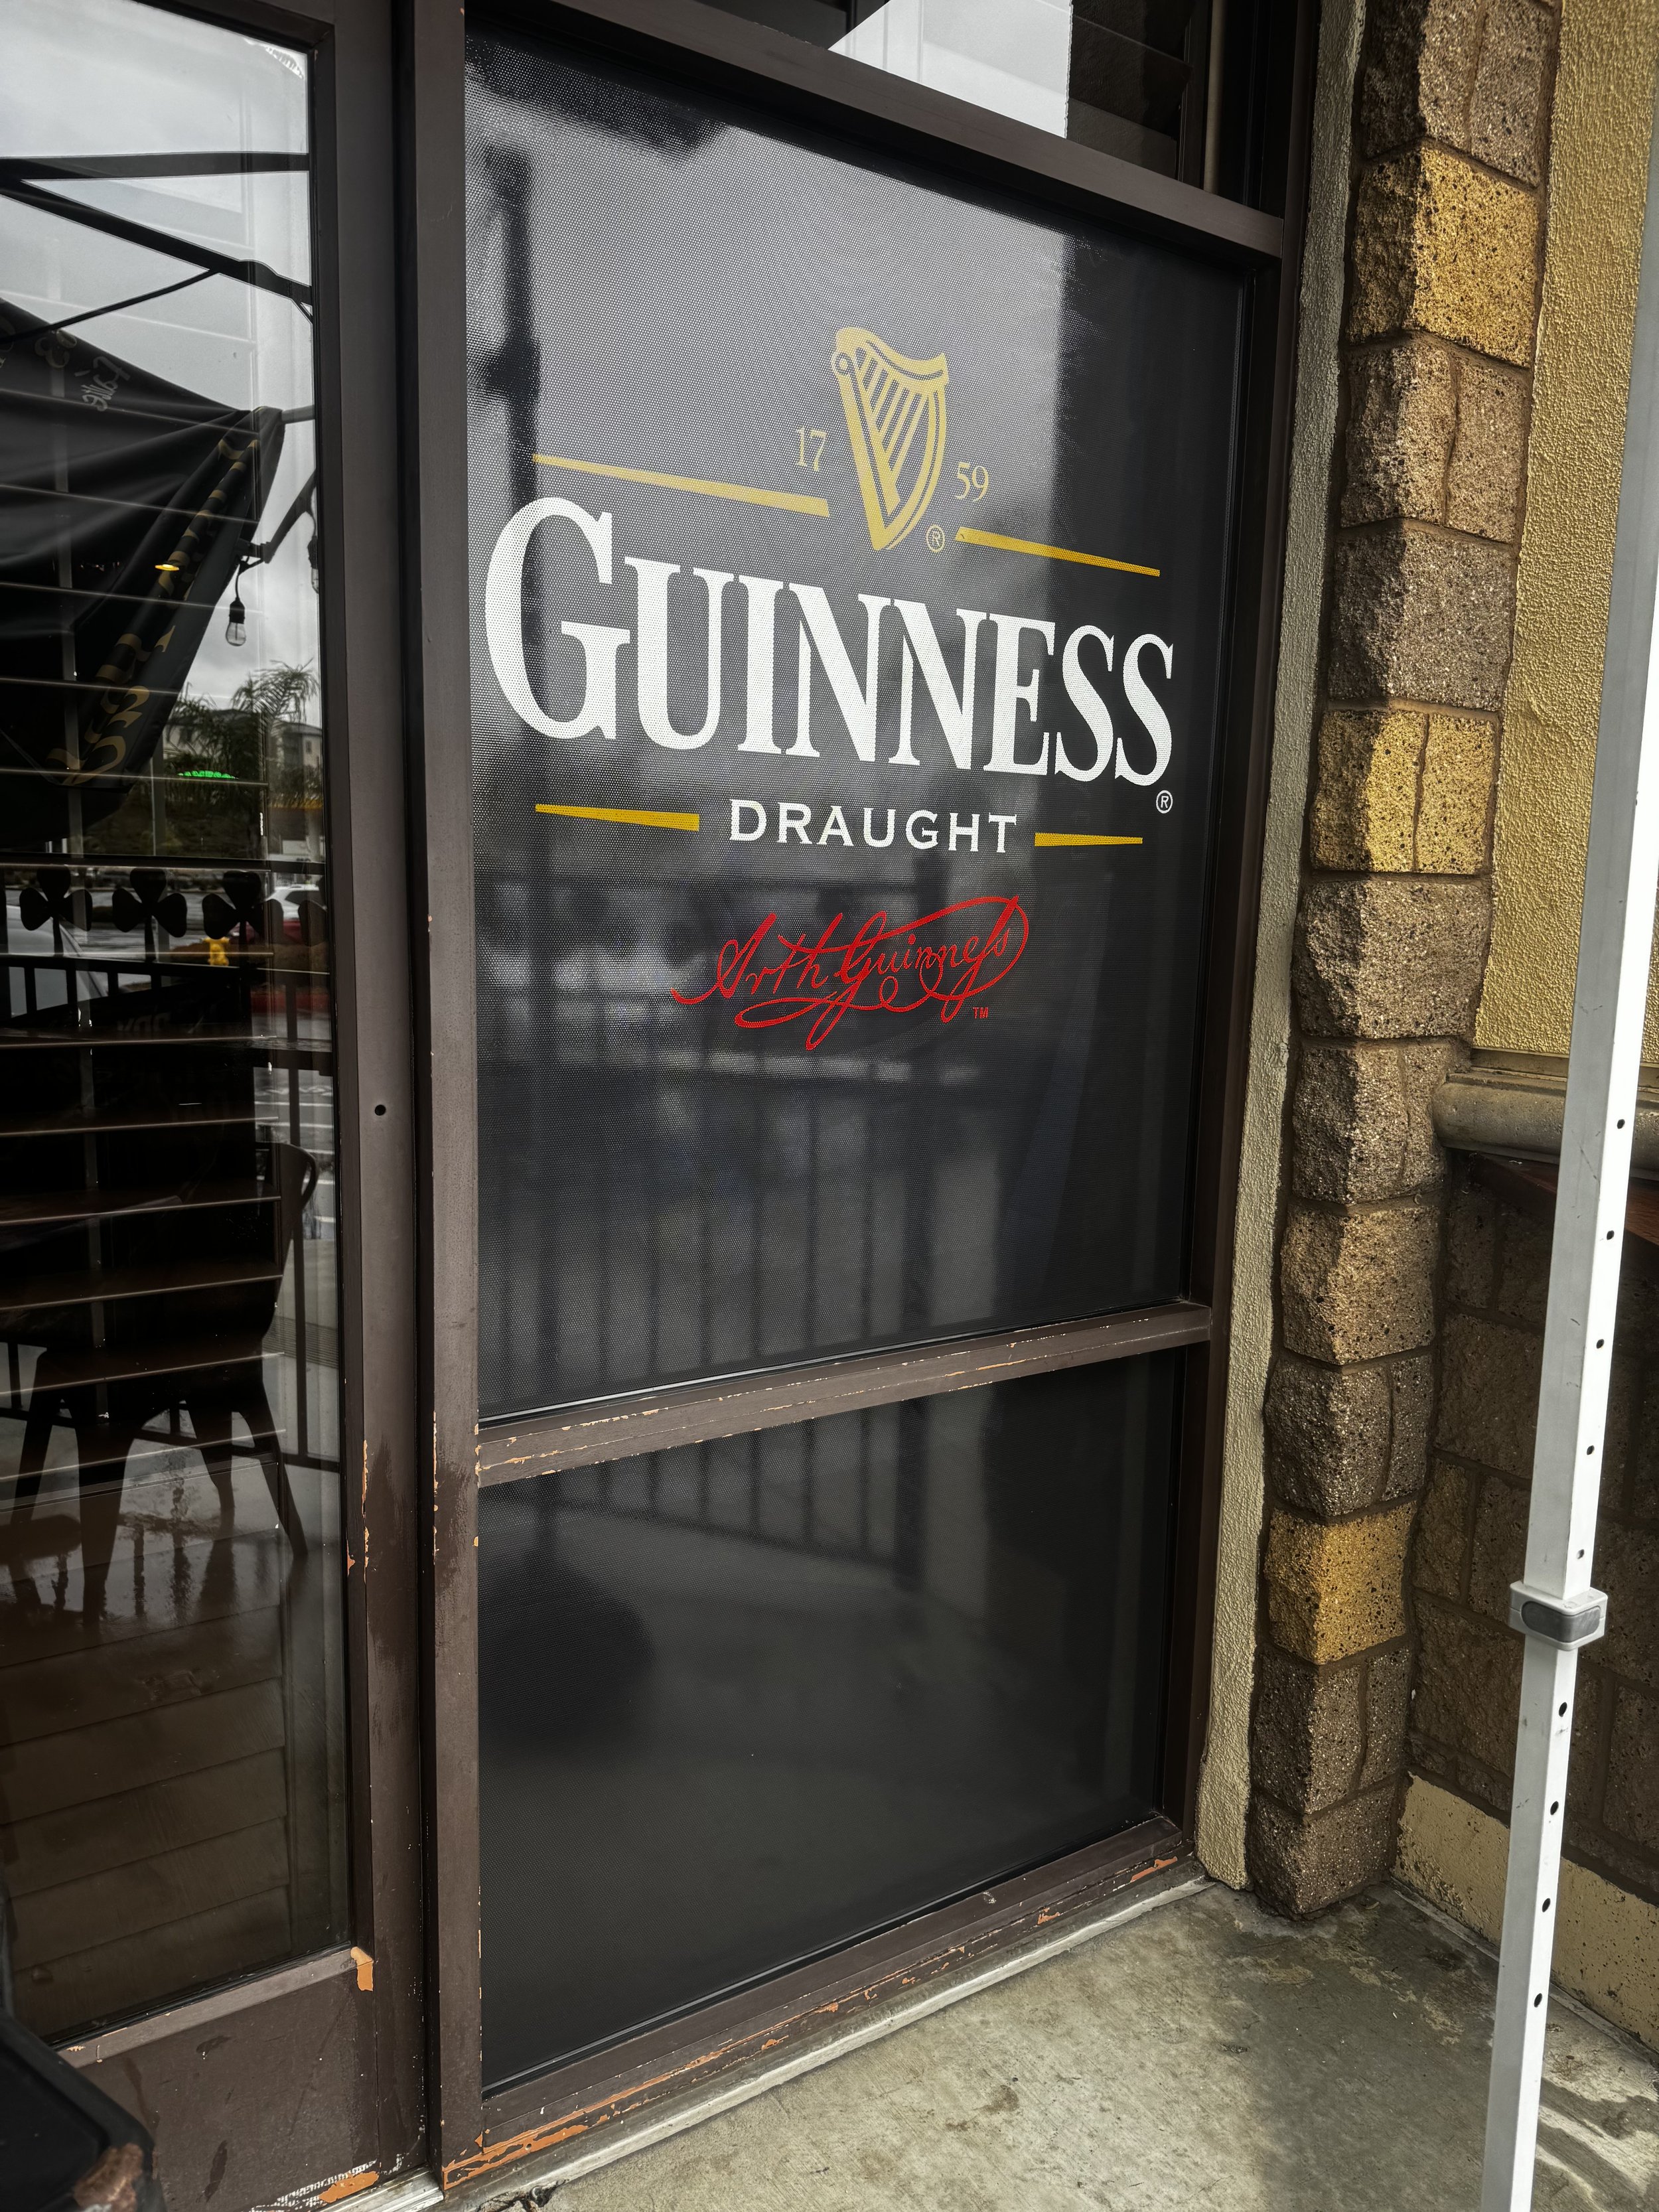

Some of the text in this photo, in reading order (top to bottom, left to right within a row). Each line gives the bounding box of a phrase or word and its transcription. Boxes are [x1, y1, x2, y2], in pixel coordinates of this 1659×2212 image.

[796, 426, 827, 472] 17
[954, 462, 989, 503] 59
[485, 496, 1174, 786] GUINNESS
[729, 798, 1017, 854] DRAUGHT
